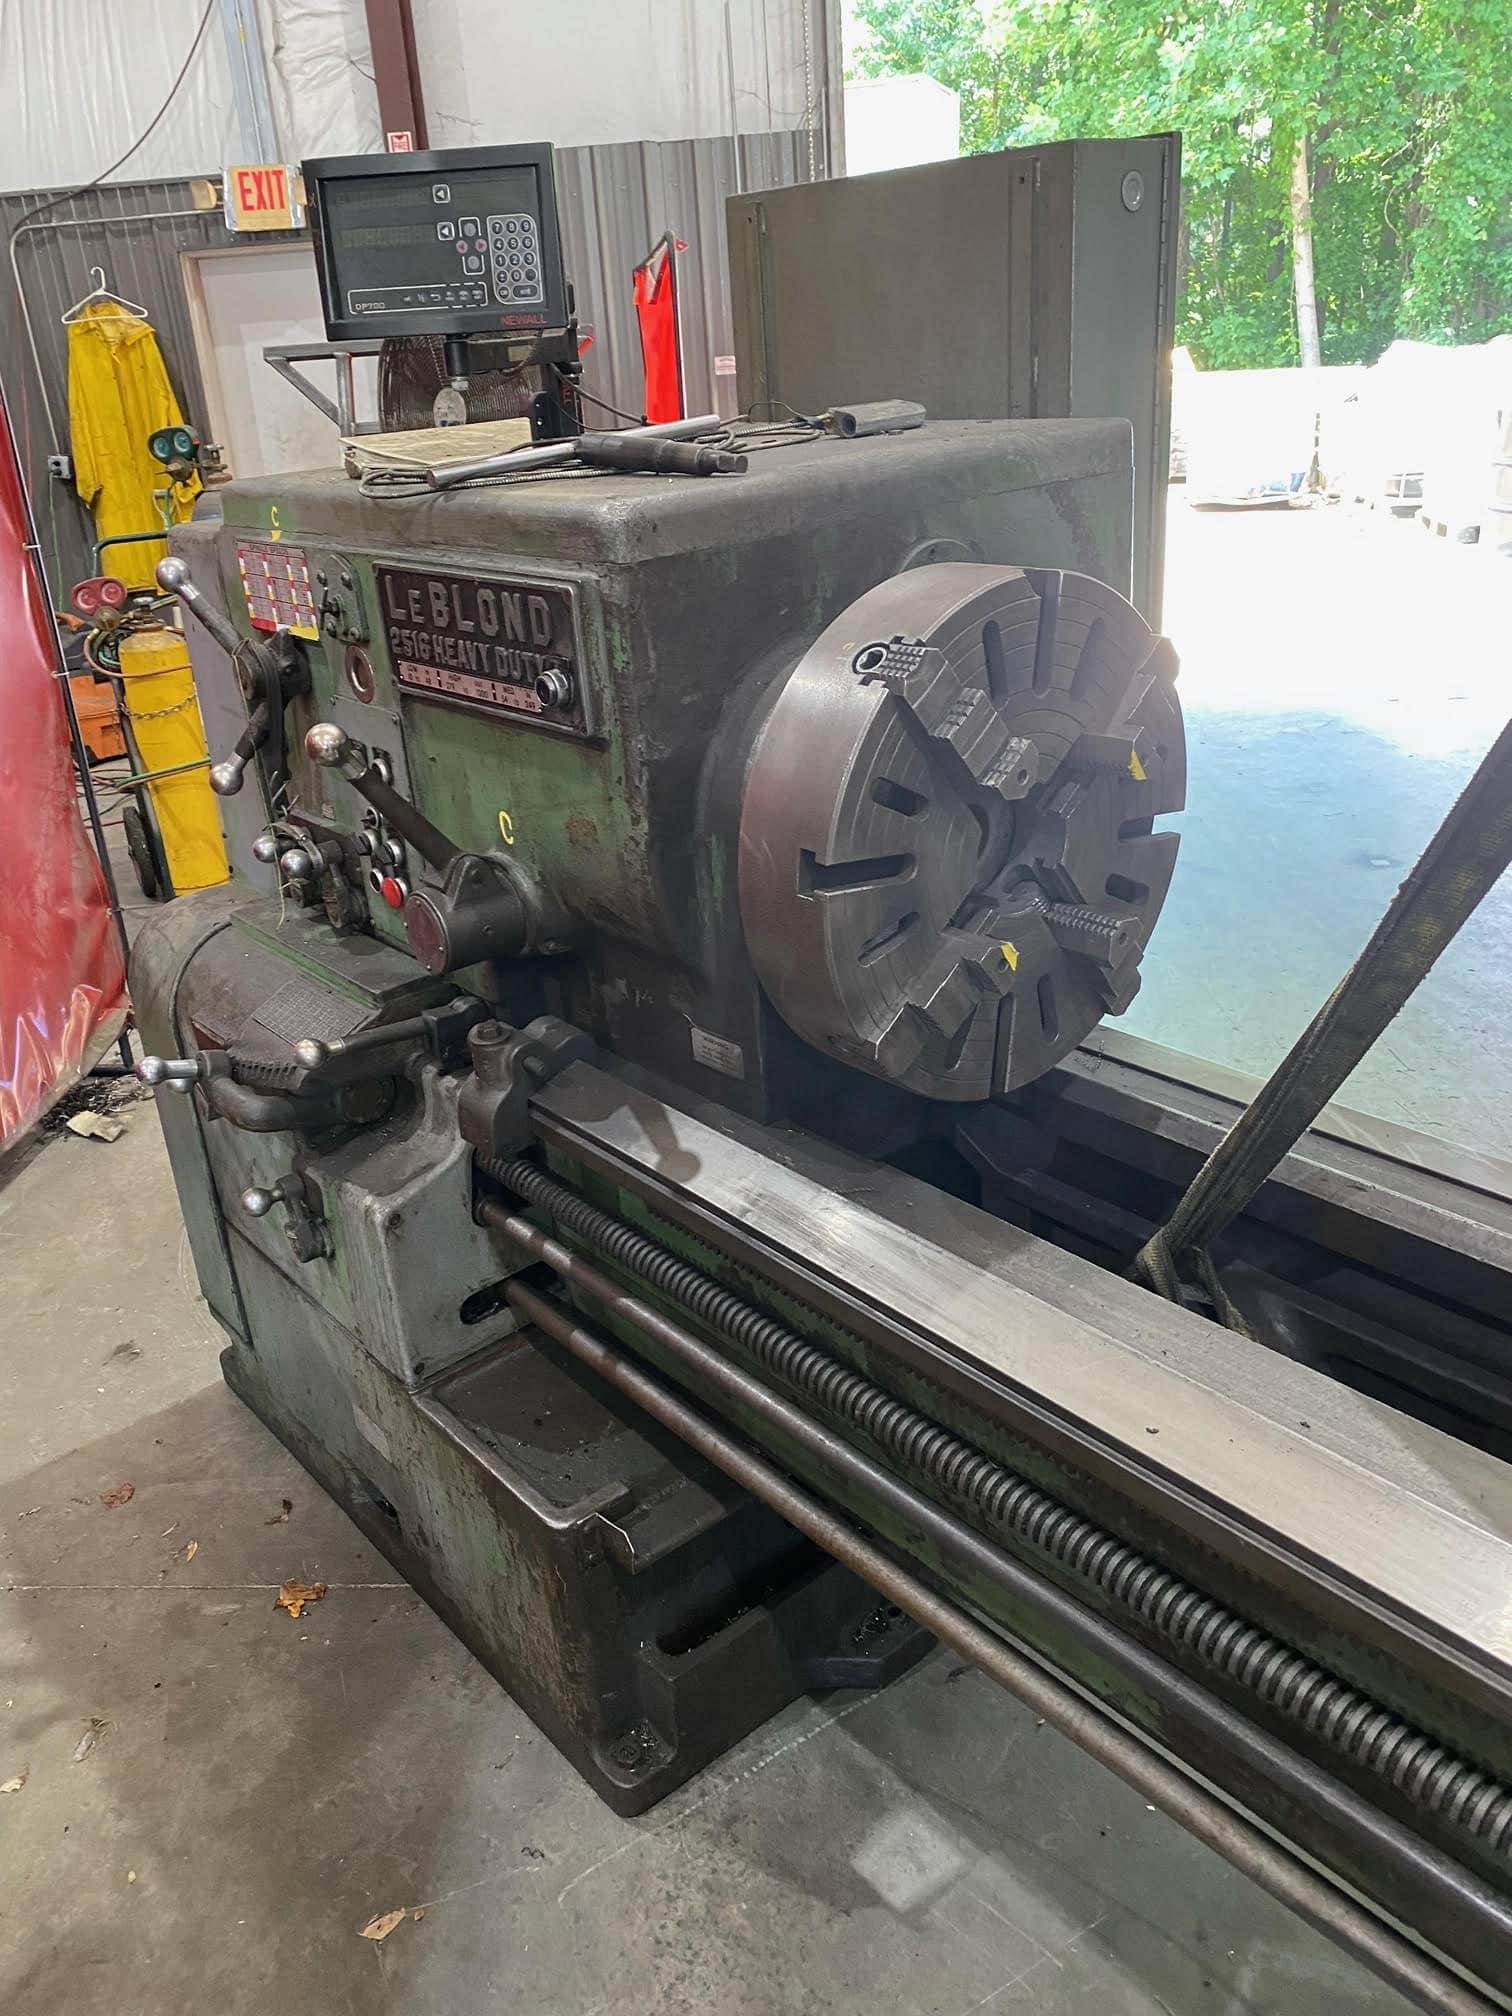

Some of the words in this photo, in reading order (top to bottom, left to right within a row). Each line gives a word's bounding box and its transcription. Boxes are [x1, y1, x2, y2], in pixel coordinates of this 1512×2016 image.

[237, 169, 285, 211] EXIT
[271, 505, 280, 527] C
[389, 626, 432, 660] 2516
[432, 634, 491, 673] HEAVY
[494, 645, 548, 683] DUTY
[499, 810, 514, 845] C
